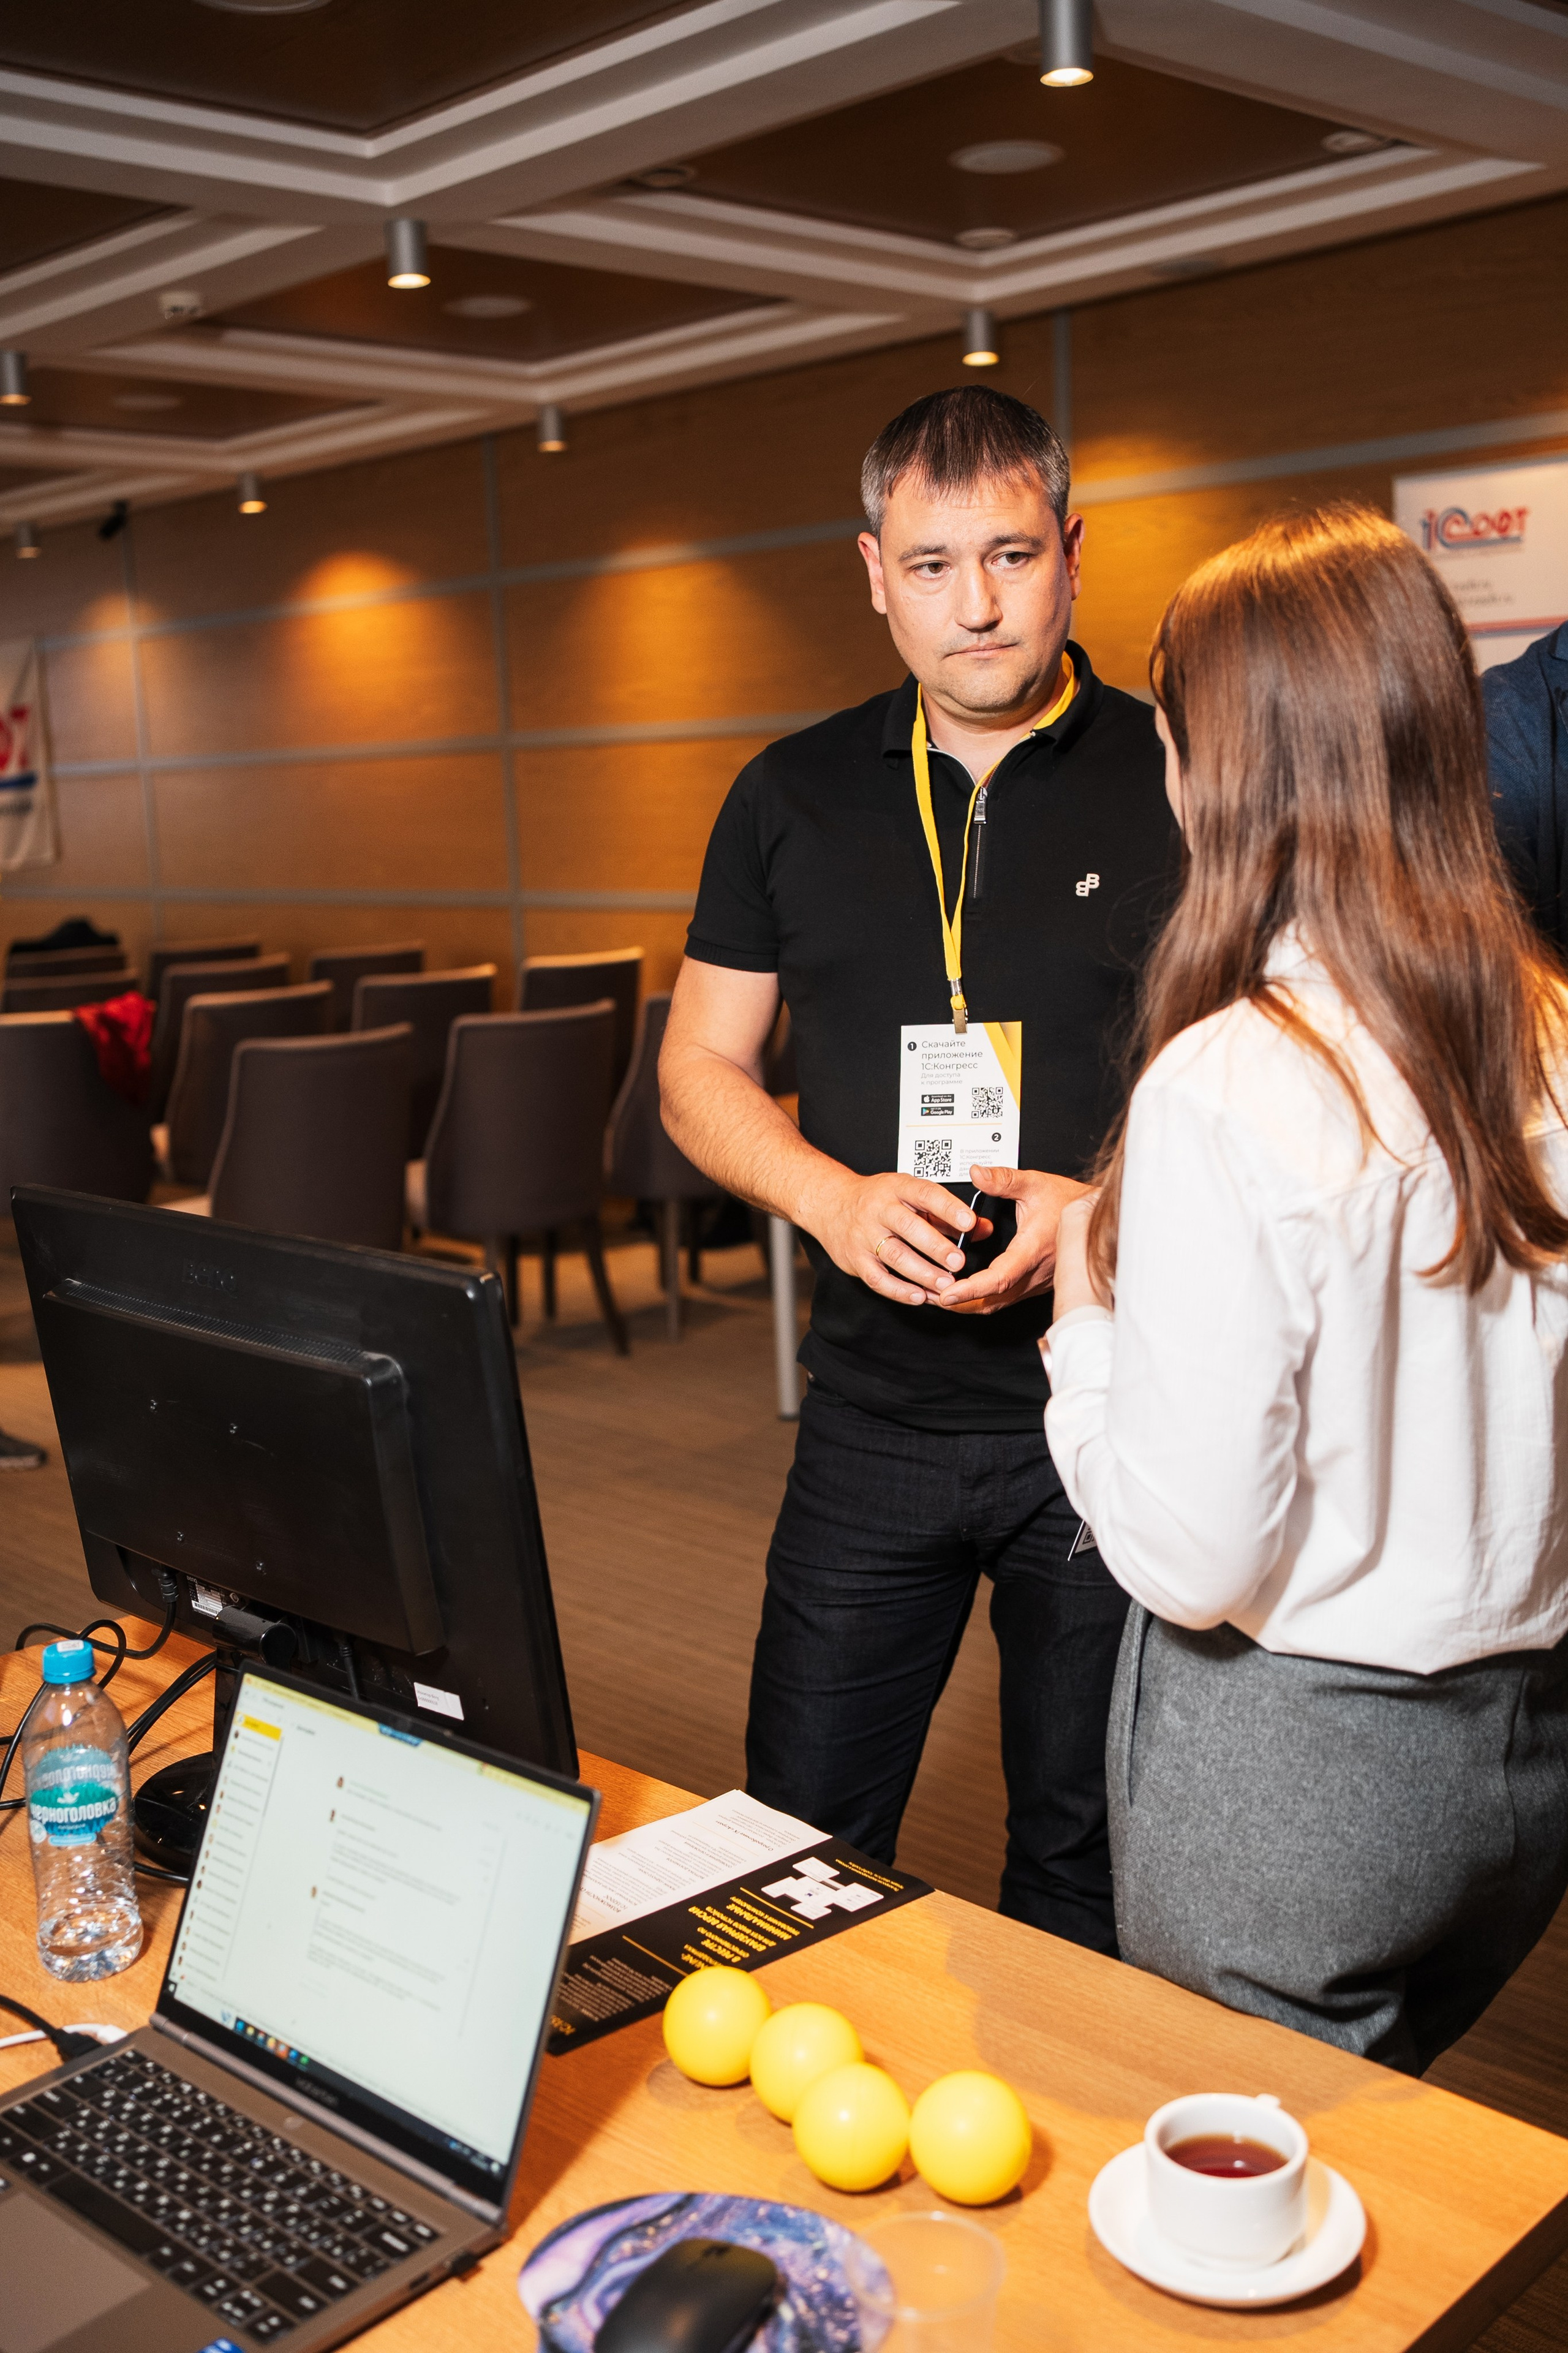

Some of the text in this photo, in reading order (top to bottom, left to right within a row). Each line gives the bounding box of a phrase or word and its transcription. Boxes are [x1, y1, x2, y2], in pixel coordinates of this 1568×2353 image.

[921, 1040, 966, 1048] Скачайте
[921, 1051, 983, 1060] приложение
[921, 1062, 978, 1071] 1С:Конгресс
